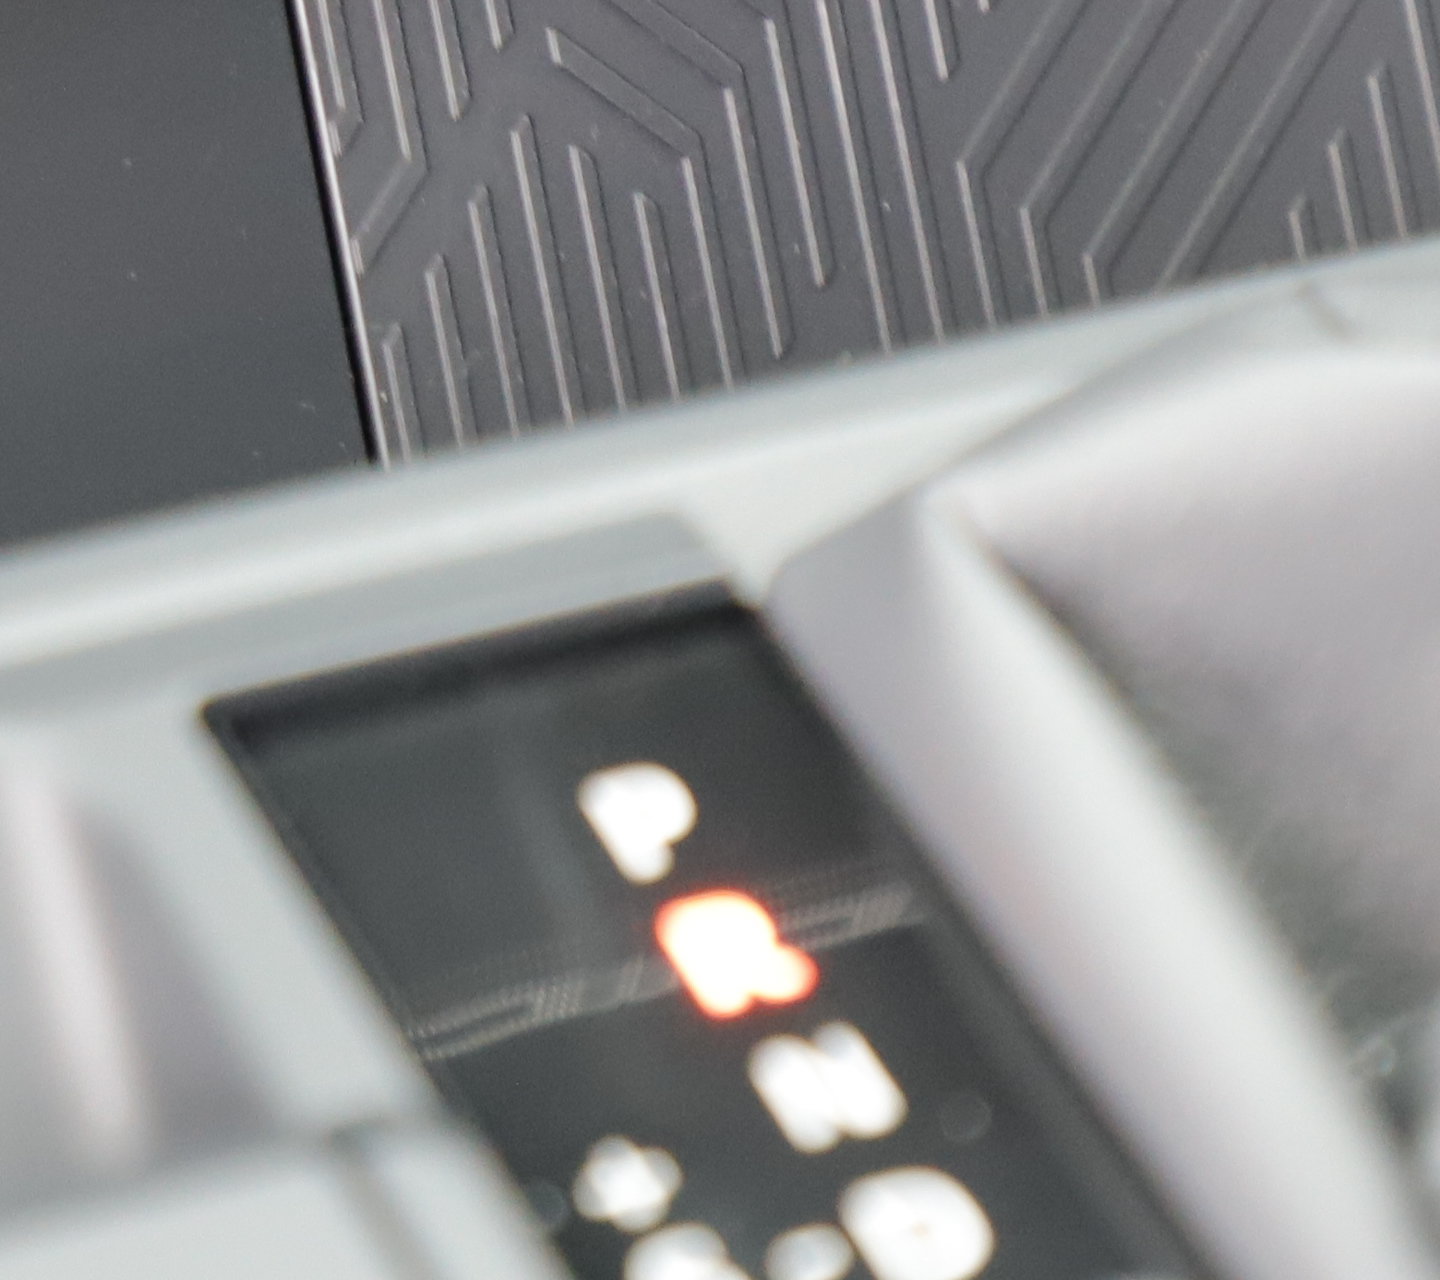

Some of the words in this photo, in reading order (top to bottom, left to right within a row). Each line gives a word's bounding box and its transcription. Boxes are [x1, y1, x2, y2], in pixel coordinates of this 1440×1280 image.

[578, 761, 698, 884] P
[654, 888, 819, 1020] R
[747, 1019, 909, 1154] N
